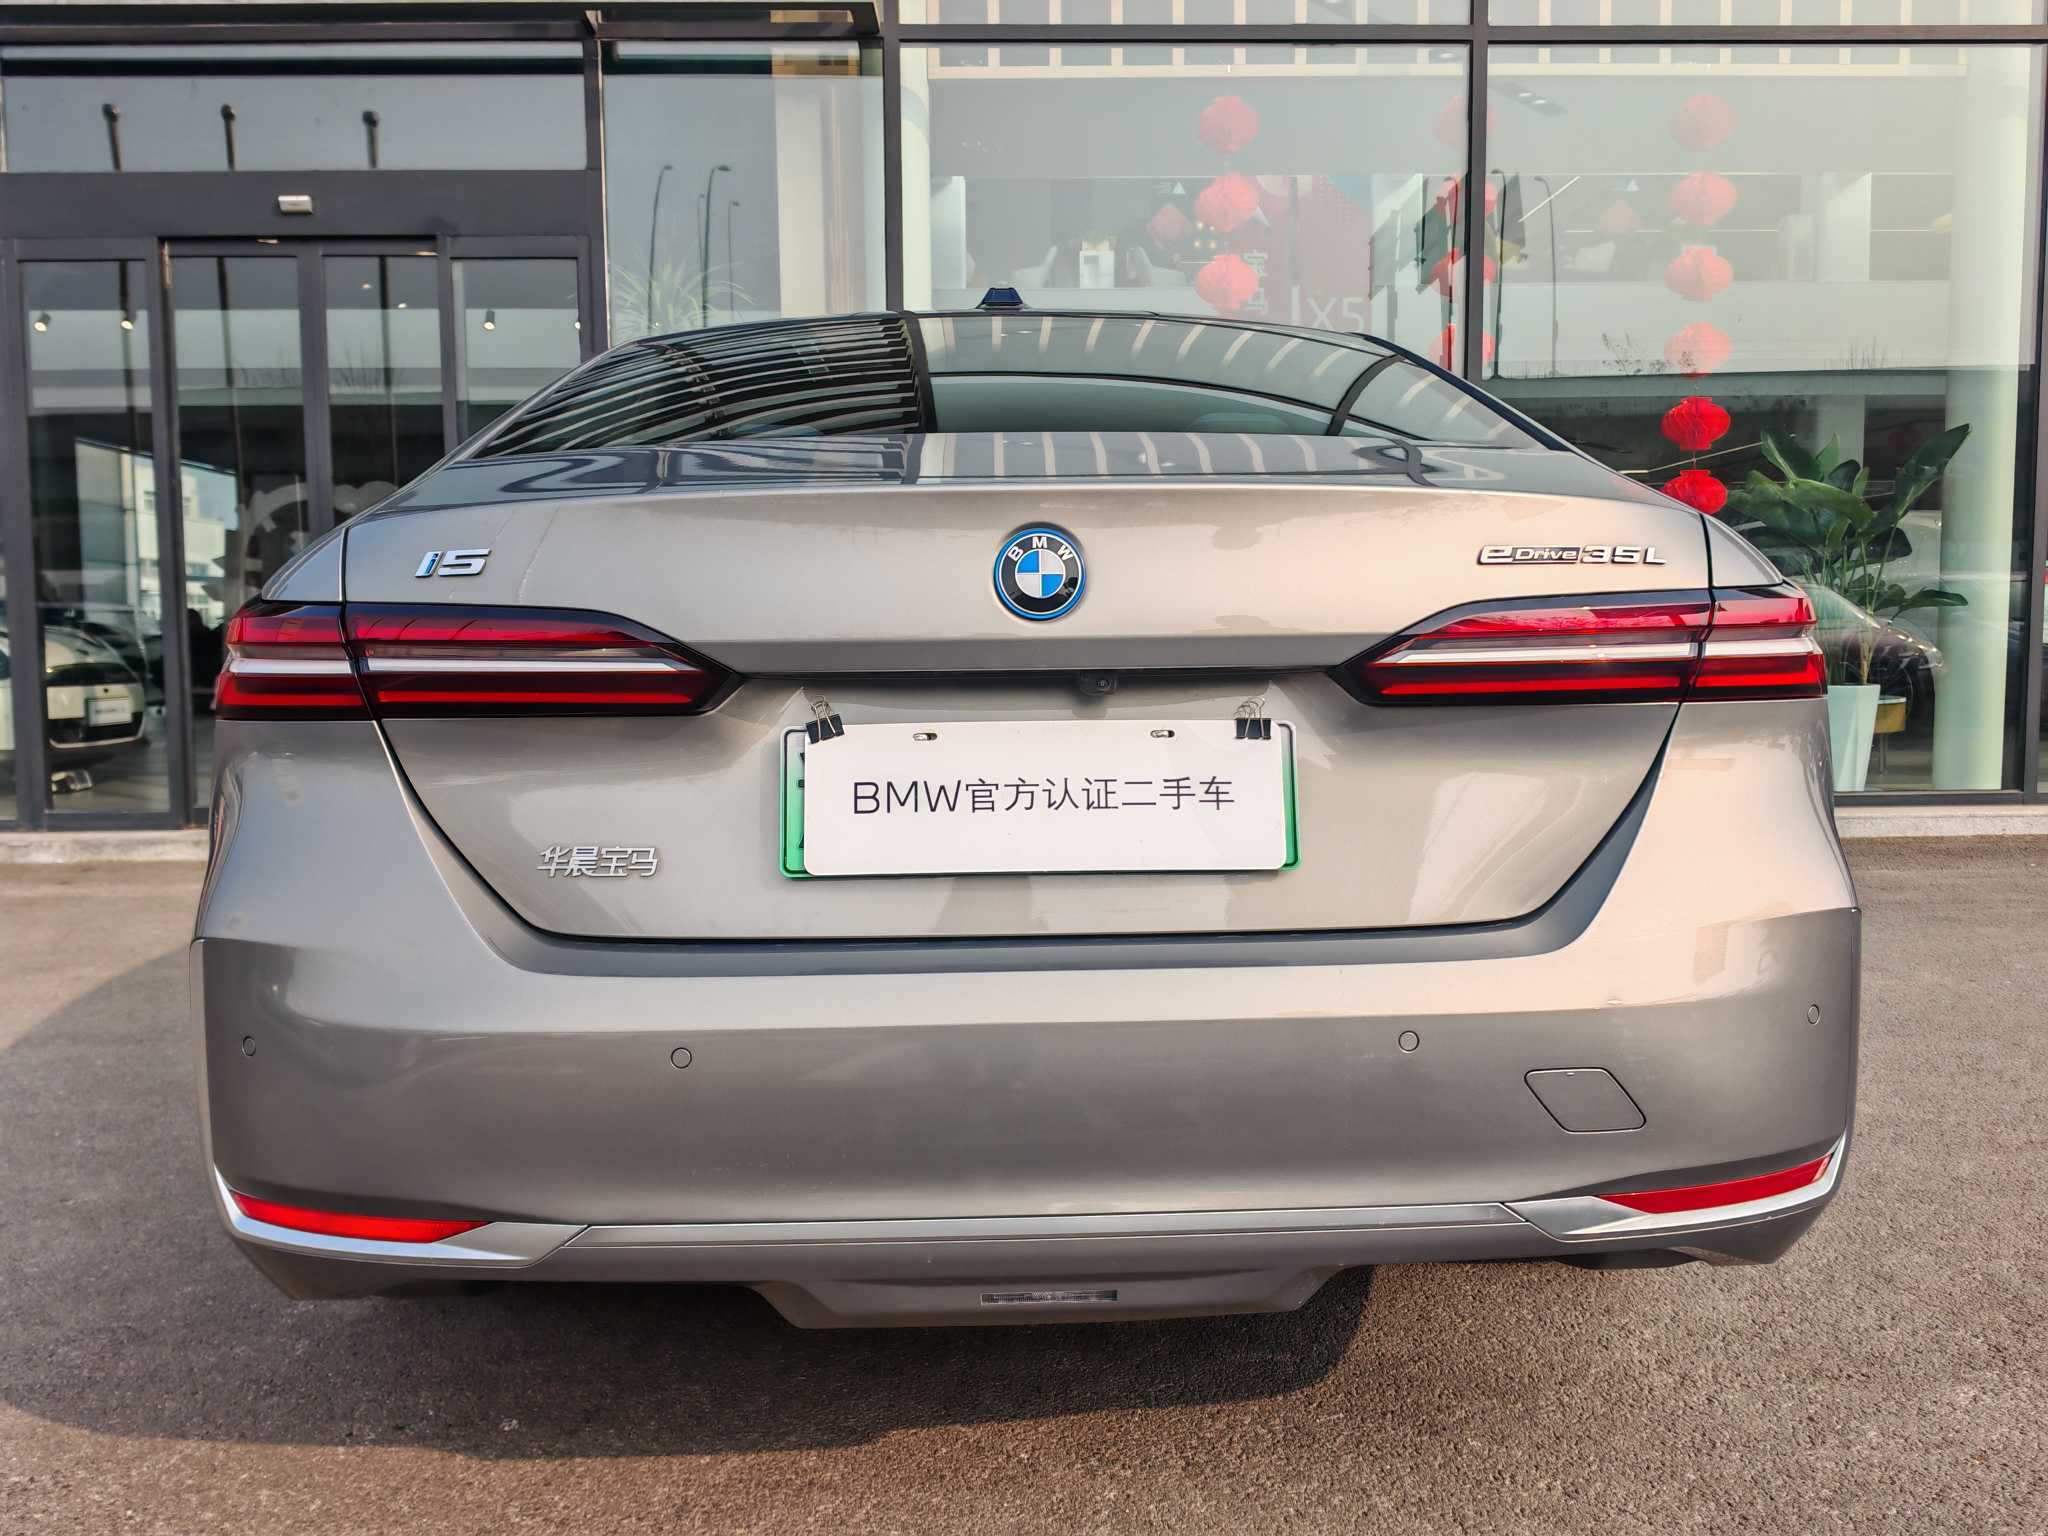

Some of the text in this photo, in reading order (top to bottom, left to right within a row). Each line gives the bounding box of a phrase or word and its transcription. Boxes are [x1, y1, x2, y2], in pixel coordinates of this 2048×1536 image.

[414, 548, 492, 578] i5
[1007, 536, 1074, 562] BMW
[853, 776, 1235, 814] BMW官方认证二手车
[537, 845, 659, 878] 华晨宝马
